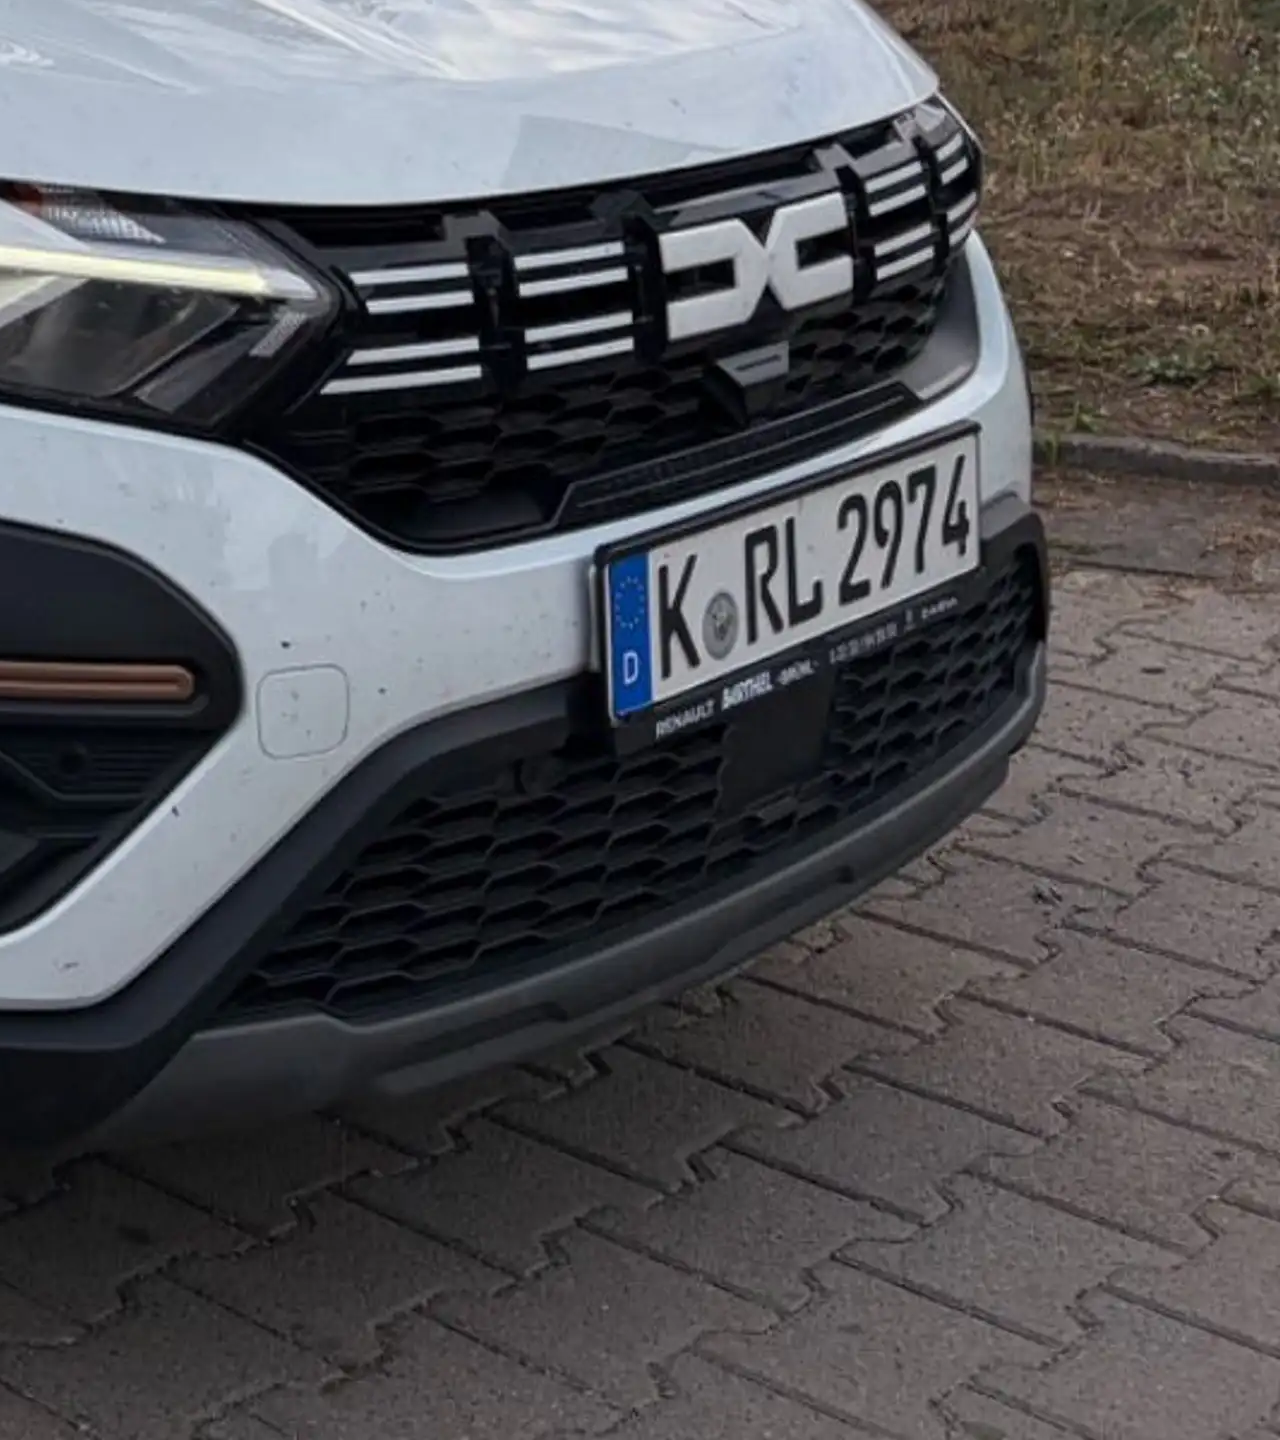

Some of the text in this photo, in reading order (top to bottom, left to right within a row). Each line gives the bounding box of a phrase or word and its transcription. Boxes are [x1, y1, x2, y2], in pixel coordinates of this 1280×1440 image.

[657, 454, 971, 680] K RL 2974
[622, 651, 639, 685] D
